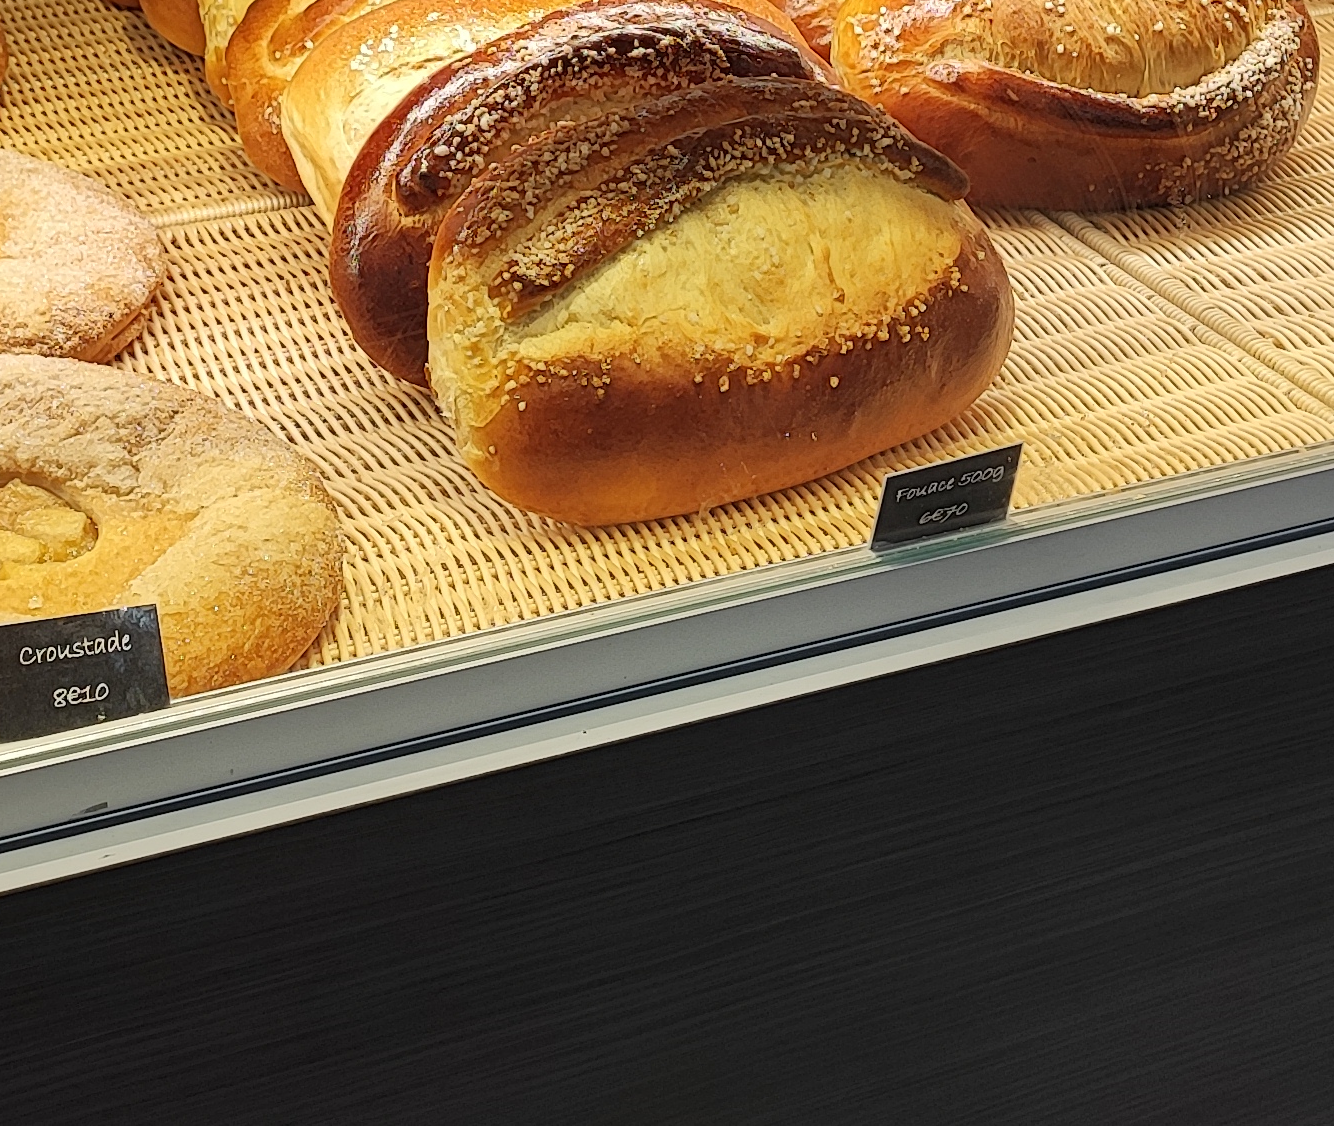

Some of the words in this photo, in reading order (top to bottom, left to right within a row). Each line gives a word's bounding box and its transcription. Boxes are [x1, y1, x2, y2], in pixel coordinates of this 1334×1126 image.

[896, 477, 955, 503] Fouace
[958, 466, 1005, 483] 500g
[19, 630, 132, 665] Croustade
